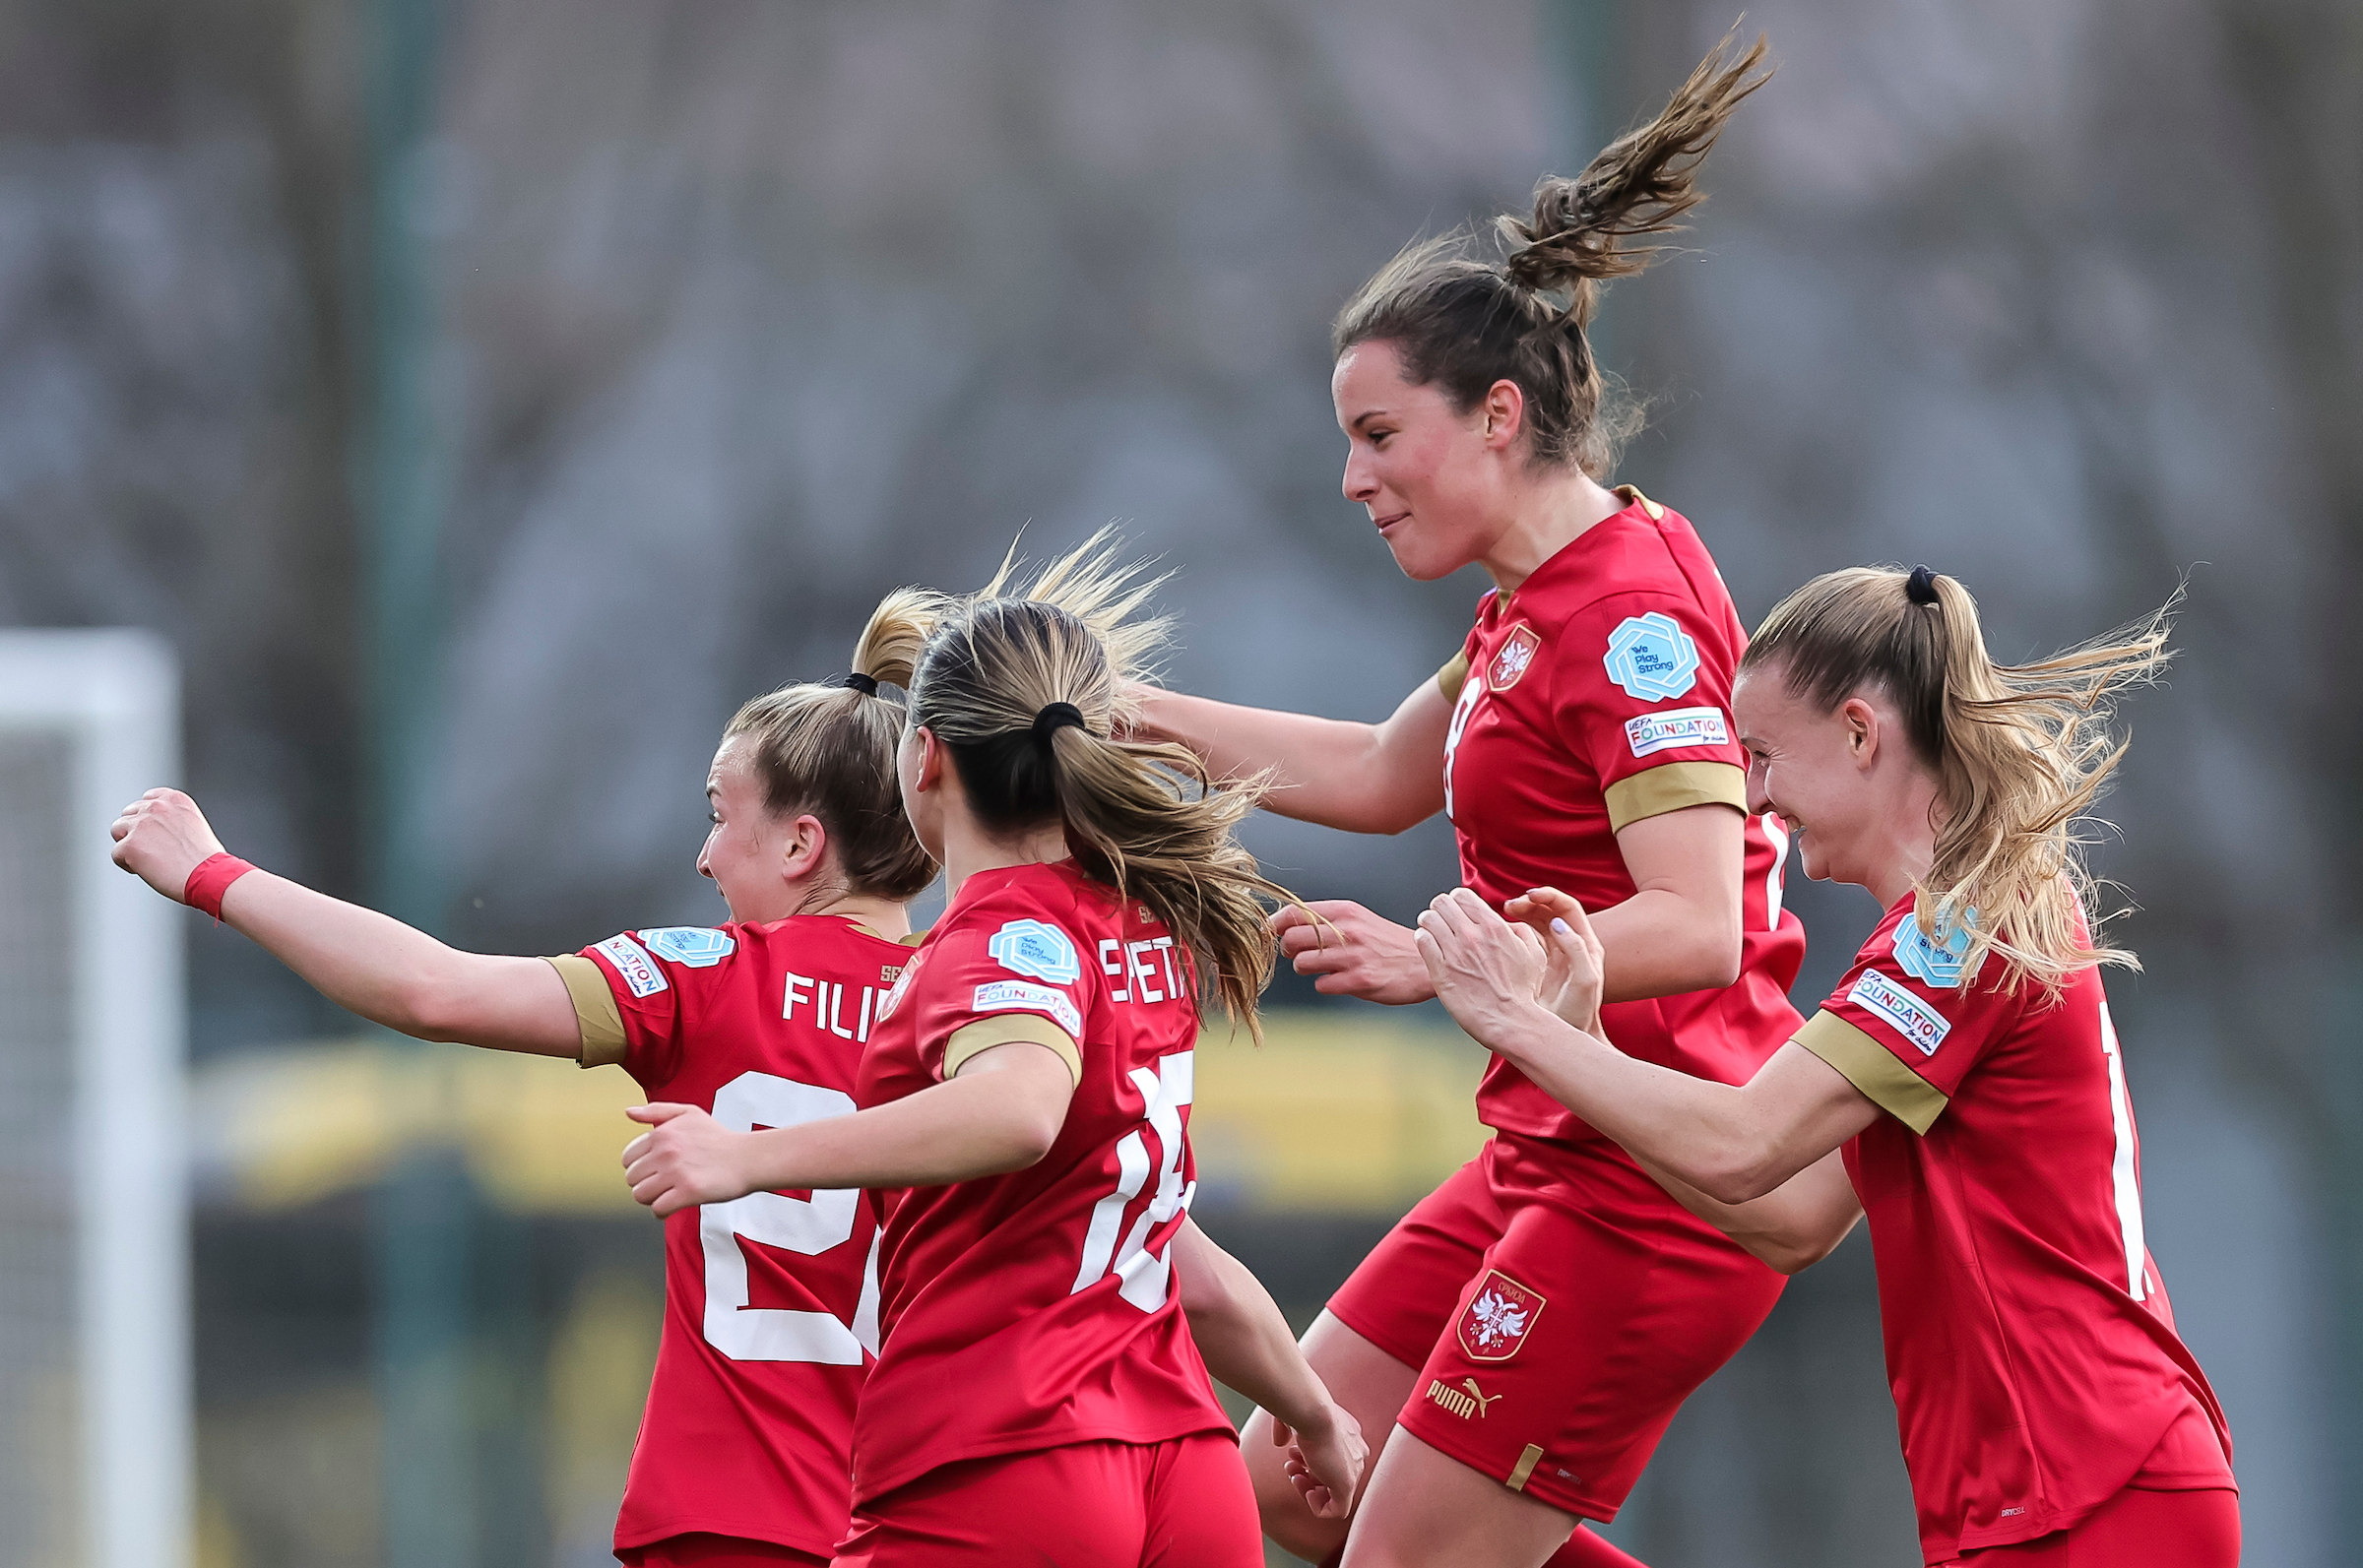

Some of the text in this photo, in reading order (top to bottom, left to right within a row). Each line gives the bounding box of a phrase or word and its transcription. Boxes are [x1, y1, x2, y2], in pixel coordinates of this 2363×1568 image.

[1631, 645, 1648, 654] We
[1635, 654, 1658, 665] Play
[1638, 660, 1674, 674] Strong
[1629, 718, 1652, 731] UEFA
[1630, 720, 1723, 745] FOUNDATION
[978, 989, 1077, 1028] FOUNDATION
[2098, 1001, 2155, 1302] 1
[699, 1070, 881, 1366] 2
[1426, 1379, 1477, 1420] PUMA
